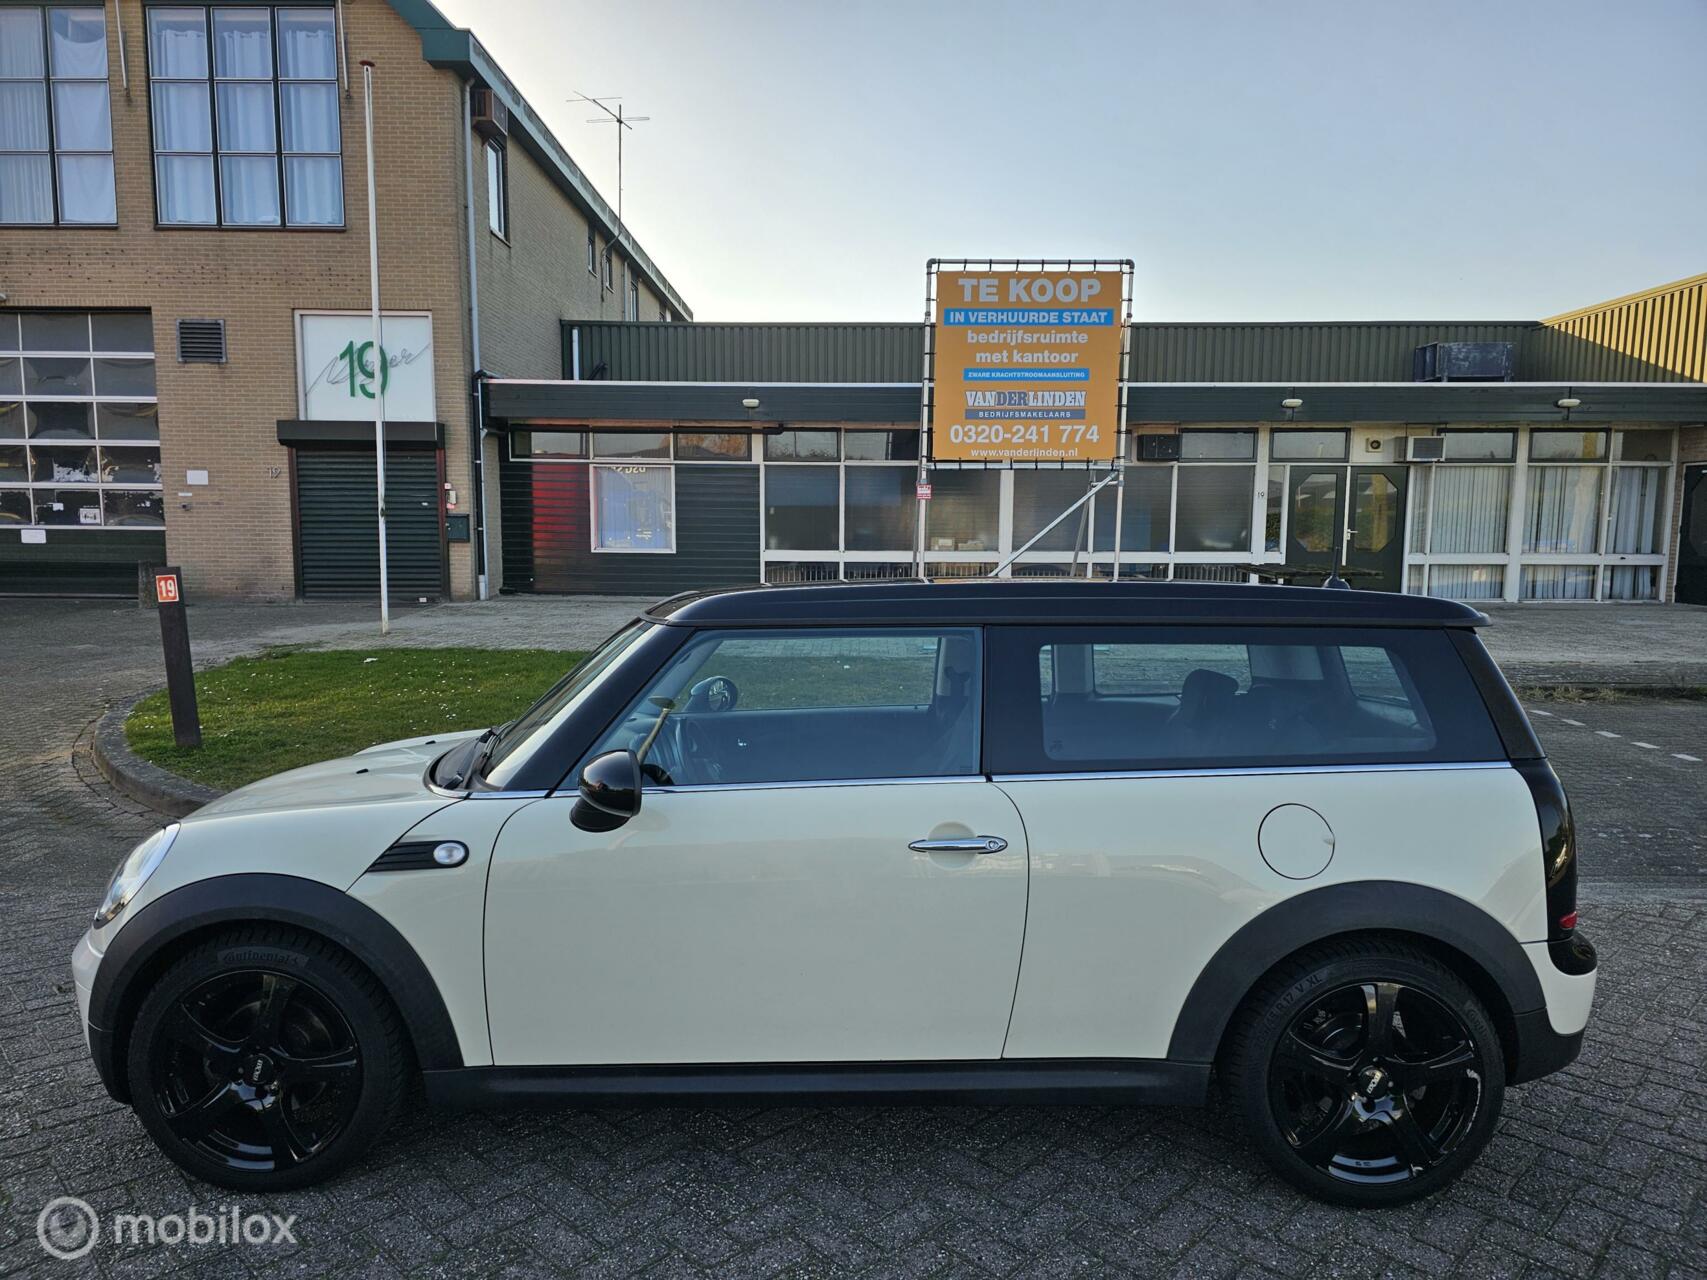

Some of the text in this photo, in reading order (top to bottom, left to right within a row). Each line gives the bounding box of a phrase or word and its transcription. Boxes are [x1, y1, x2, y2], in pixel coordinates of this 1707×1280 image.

[958, 278, 1101, 303] TE KOOP
[950, 312, 1108, 323] IN VERHUURDE STAAT
[967, 330, 1088, 346] bedrijfsruimte
[976, 350, 1078, 363] met kantoor
[339, 340, 388, 399] 19
[965, 390, 1087, 407] VANDERLINDEN
[950, 425, 1100, 444] 0320-241 774
[970, 448, 1078, 457] www.vanderlinden.nl
[160, 580, 175, 597] 19
[1307, 974, 1322, 987] XL
